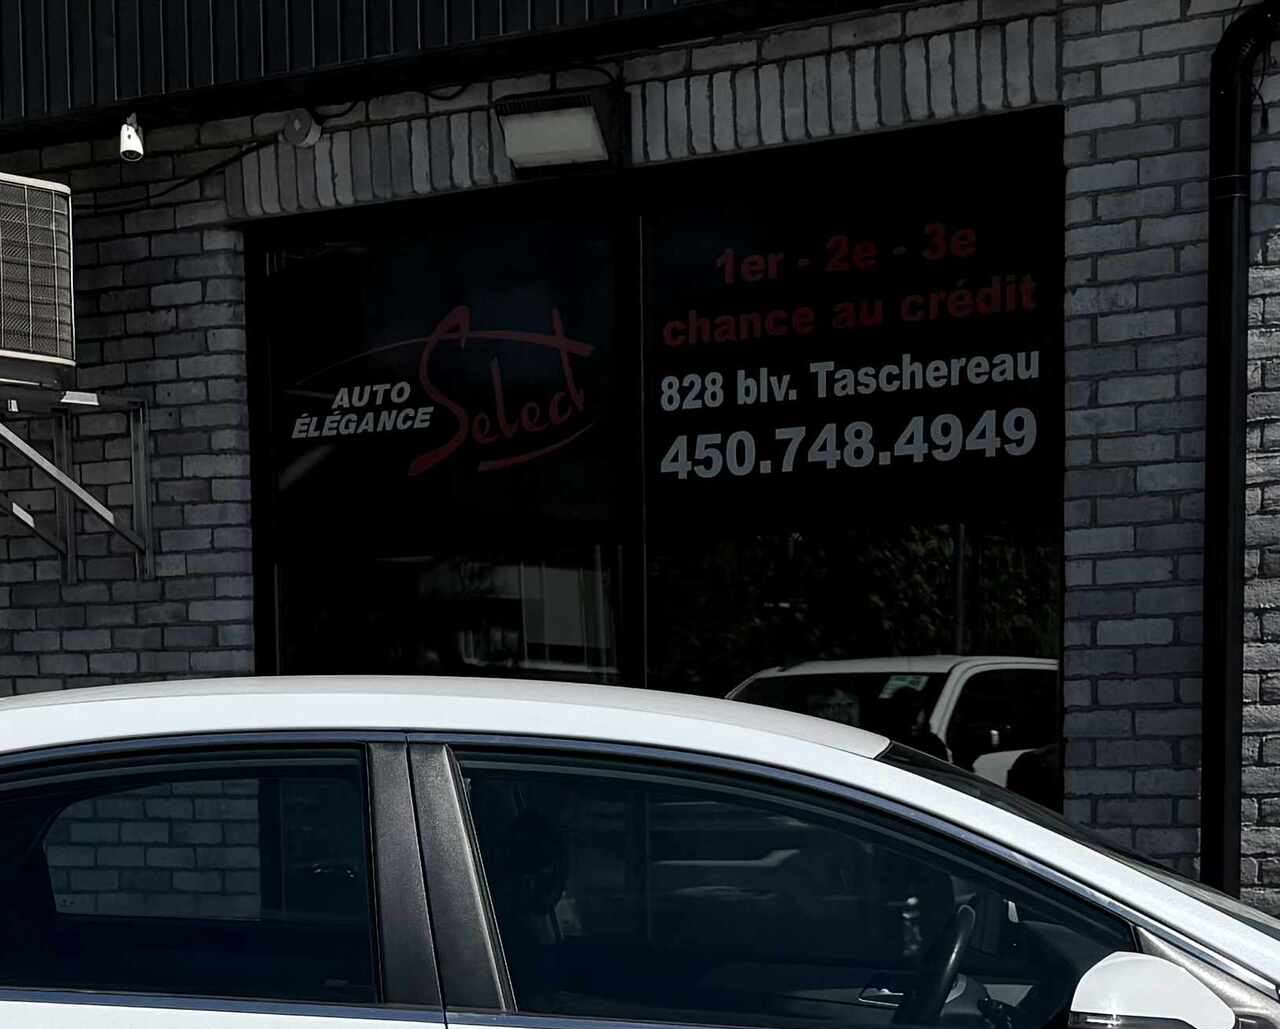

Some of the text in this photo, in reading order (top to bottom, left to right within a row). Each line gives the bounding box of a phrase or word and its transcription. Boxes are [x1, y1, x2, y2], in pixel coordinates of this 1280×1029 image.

[713, 247, 785, 286] 1er
[823, 231, 880, 273] 2e
[922, 222, 978, 264] 3e
[661, 273, 1039, 350] chance au crédit
[331, 380, 413, 411] AUTO
[407, 304, 596, 479] Select
[659, 349, 1040, 412] 828 blv. Taschereau
[290, 405, 435, 441] ÉLÉGANCE
[659, 406, 1039, 480] 450.748.4949
